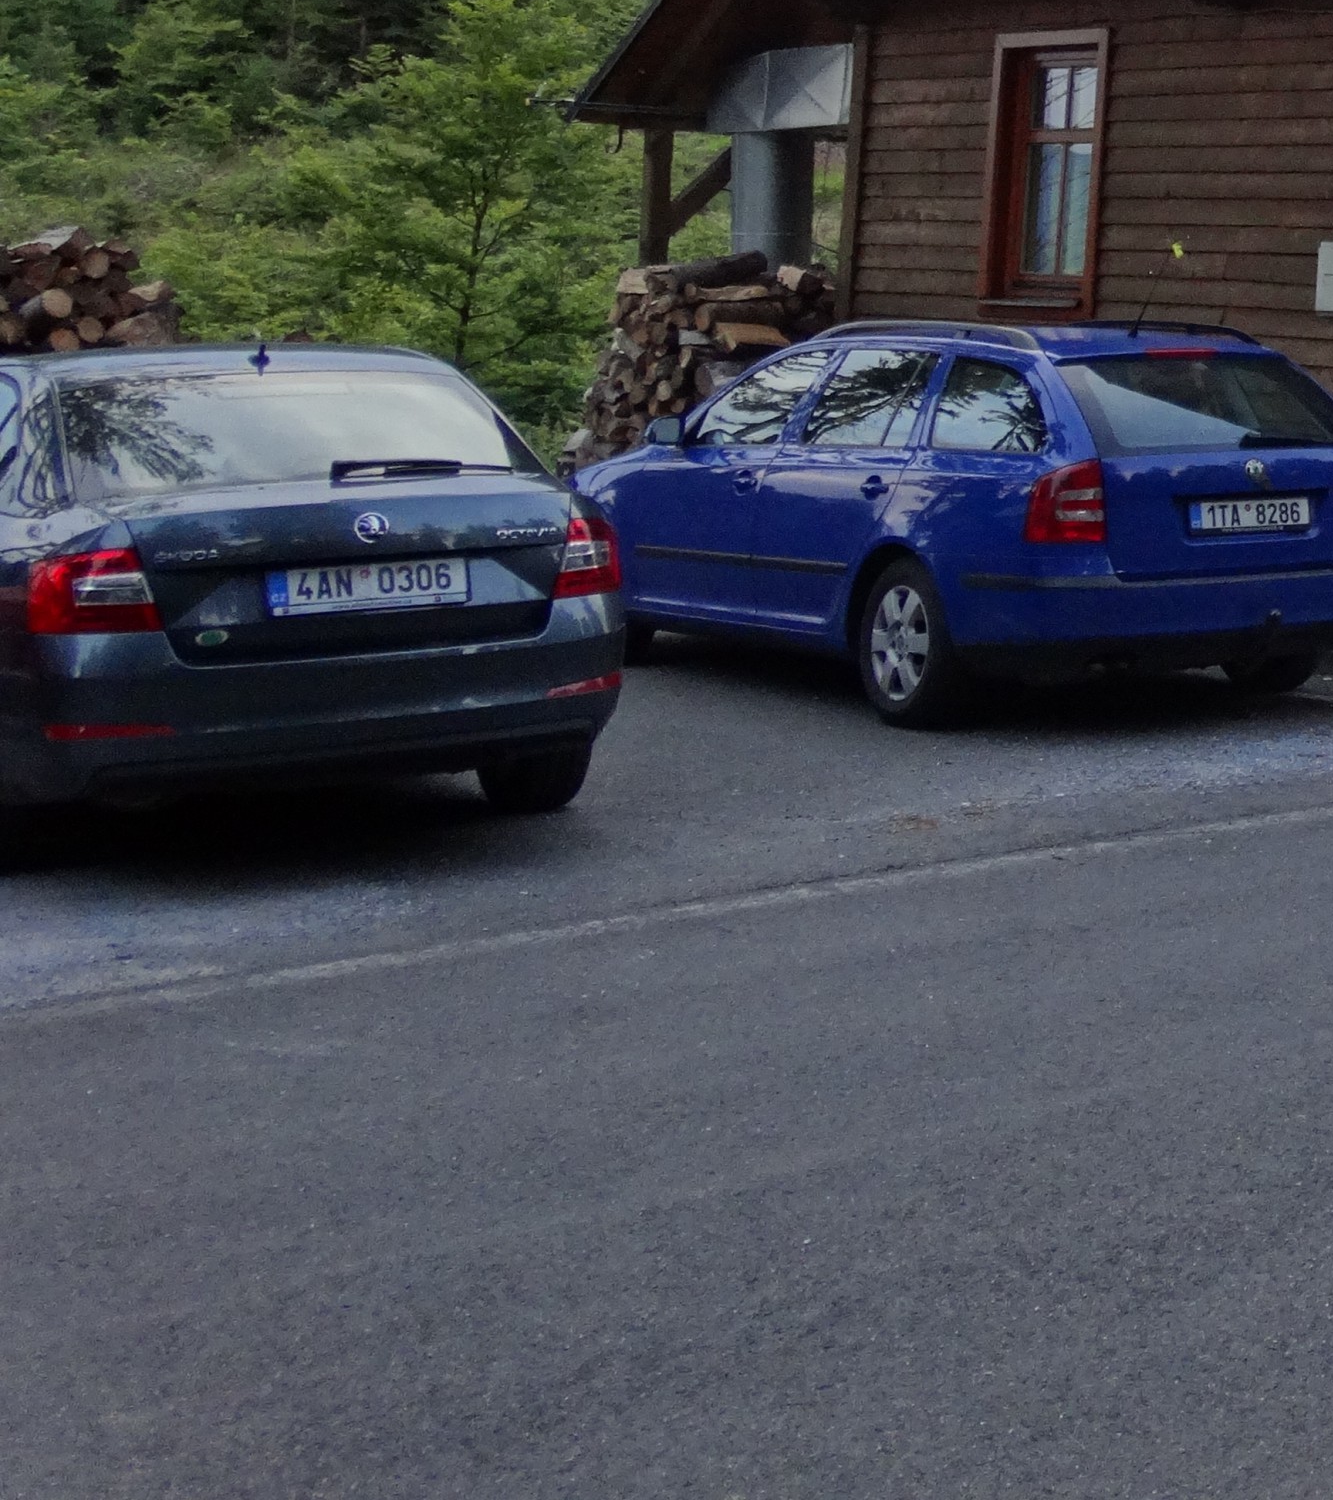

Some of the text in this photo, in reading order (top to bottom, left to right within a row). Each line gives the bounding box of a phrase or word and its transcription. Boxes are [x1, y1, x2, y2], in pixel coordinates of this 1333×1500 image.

[1207, 501, 1301, 527] 1TA 8286
[296, 562, 452, 600] 4AN 0306
